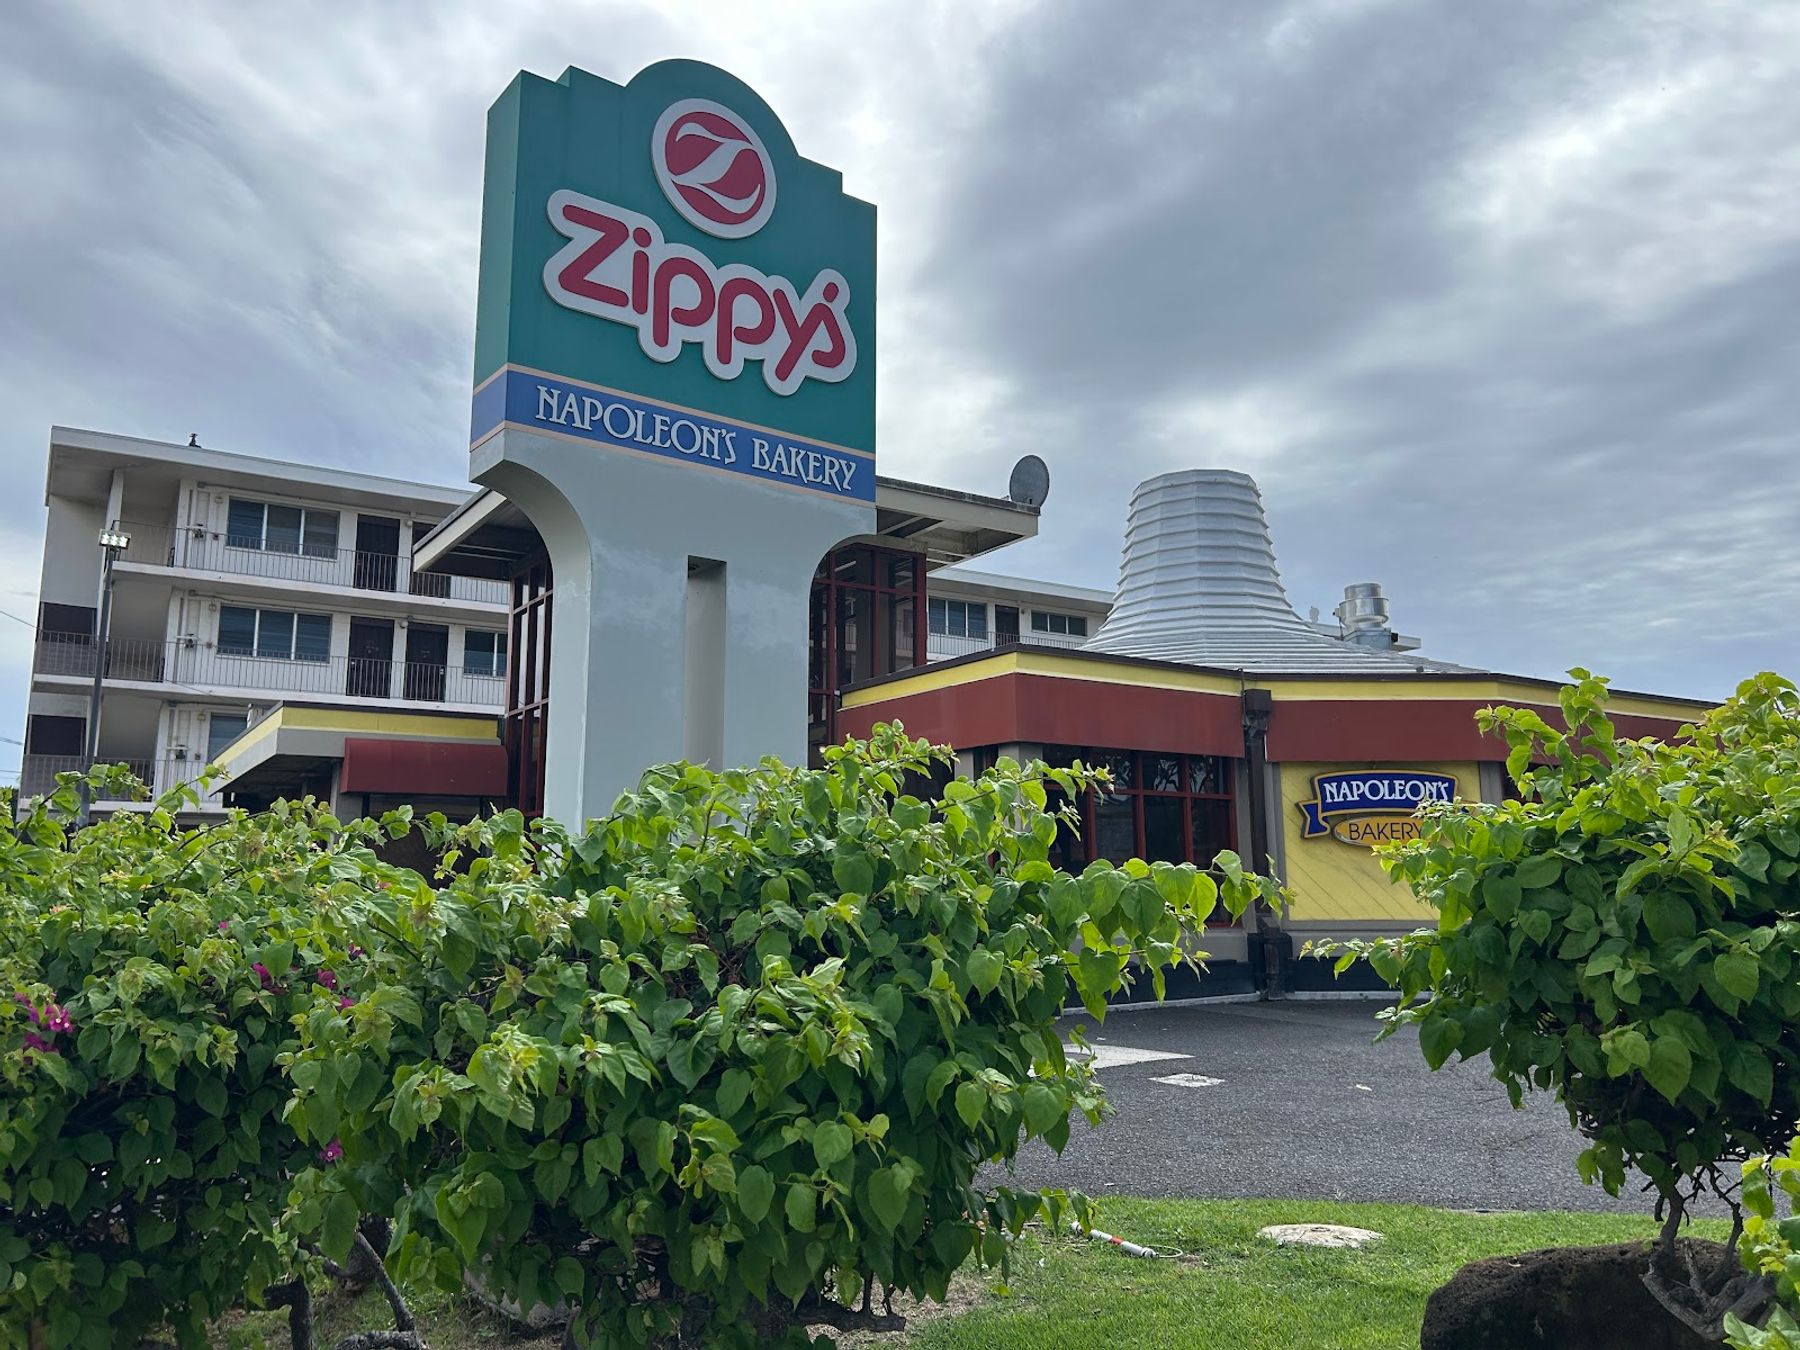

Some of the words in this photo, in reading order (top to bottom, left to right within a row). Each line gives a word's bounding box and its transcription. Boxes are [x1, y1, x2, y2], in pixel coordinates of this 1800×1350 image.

[558, 204, 846, 382] Zippy's
[534, 384, 737, 465] NAPOLEON'S
[751, 437, 857, 493] BAKERY
[1323, 779, 1449, 803] NAPOLEON'S
